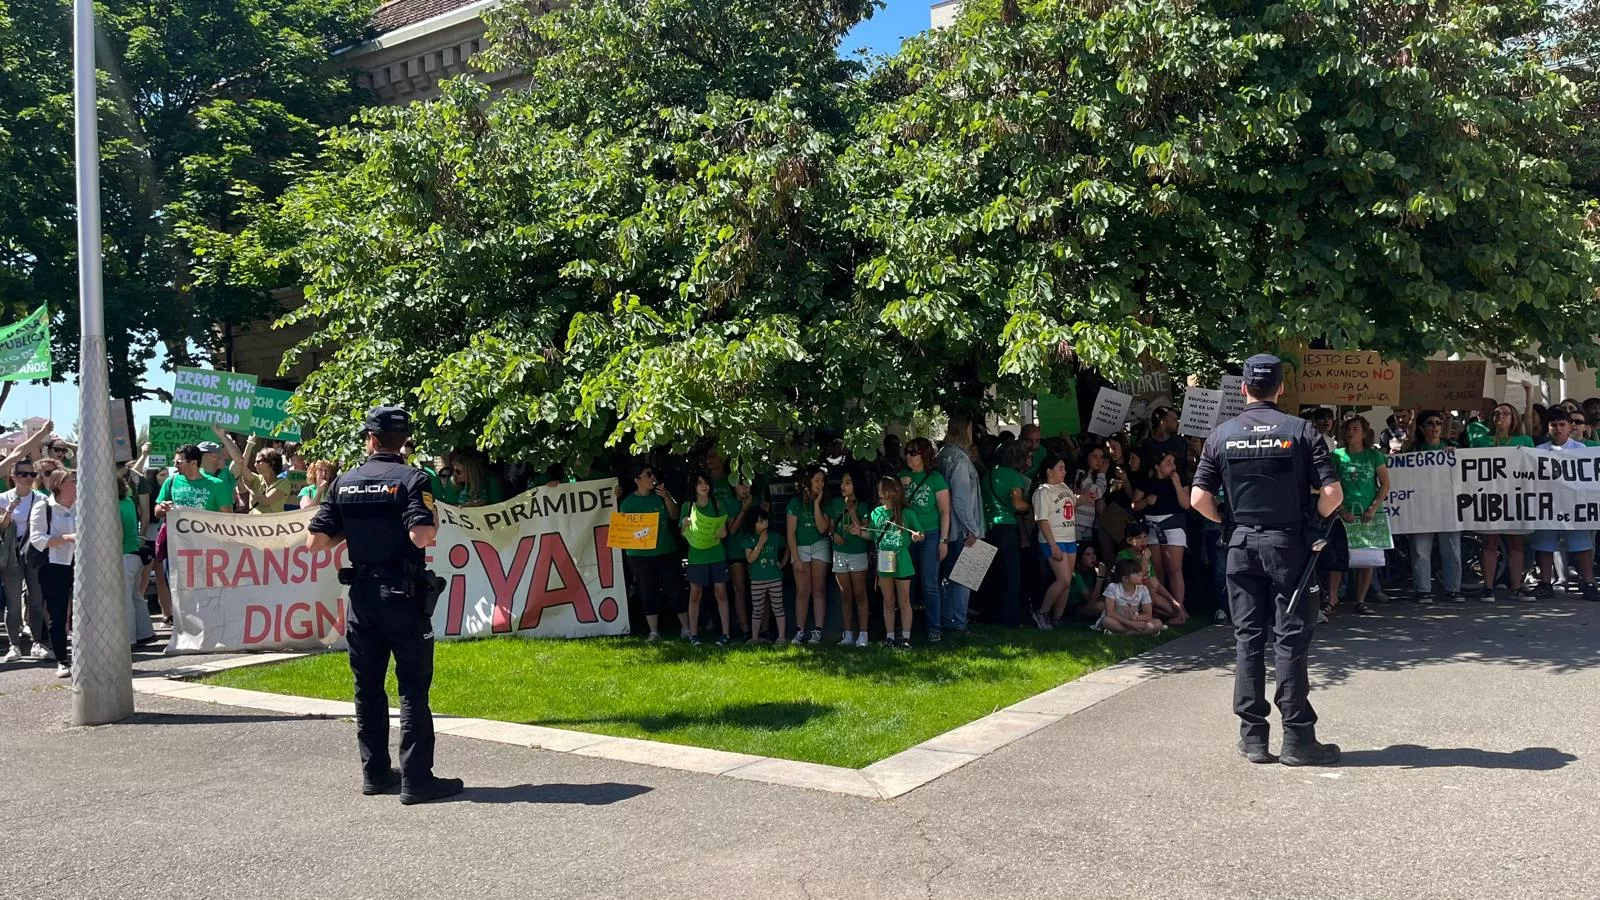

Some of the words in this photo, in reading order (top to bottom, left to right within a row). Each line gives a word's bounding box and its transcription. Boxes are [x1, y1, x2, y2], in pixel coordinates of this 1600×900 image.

[1344, 354, 1361, 365] ES
[176, 371, 221, 389] ERROR
[227, 377, 256, 394] 404:
[1326, 368, 1369, 379] KUANDO
[1372, 367, 1394, 381] NO
[1356, 381, 1369, 392] LA
[173, 388, 231, 409] RECURSO
[234, 396, 251, 410] NO
[173, 406, 240, 424] ENCONTRADO
[151, 431, 162, 441] Y
[163, 429, 205, 441] CAJAL
[1225, 438, 1283, 450] POLICIA
[1461, 457, 1508, 482] POR
[1512, 471, 1535, 481] UNA
[338, 484, 389, 495] POLICIA
[175, 518, 305, 537] COMUNIDAD
[483, 487, 614, 531] PIRÁMIDE
[1556, 513, 1571, 522] DE
[1574, 502, 1600, 523] CA
[445, 524, 619, 636] ¡YA!
